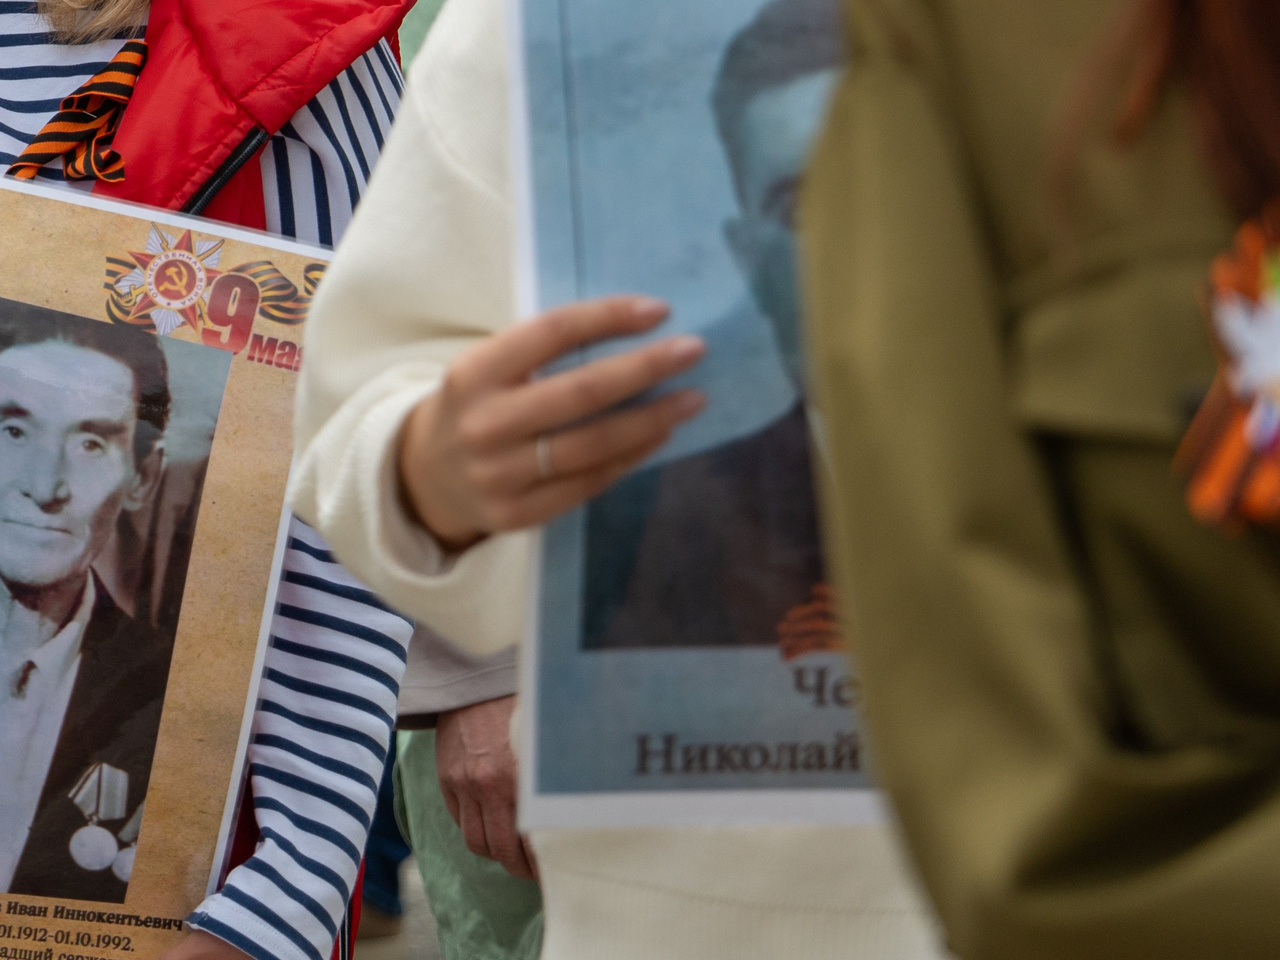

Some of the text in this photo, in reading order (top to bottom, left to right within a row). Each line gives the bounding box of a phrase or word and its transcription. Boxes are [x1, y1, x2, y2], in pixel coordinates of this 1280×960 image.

[202, 273, 260, 355] 9
[635, 731, 860, 776] Николай
[6, 901, 48, 919] Иван
[53, 905, 183, 932] Иннокентьевич
